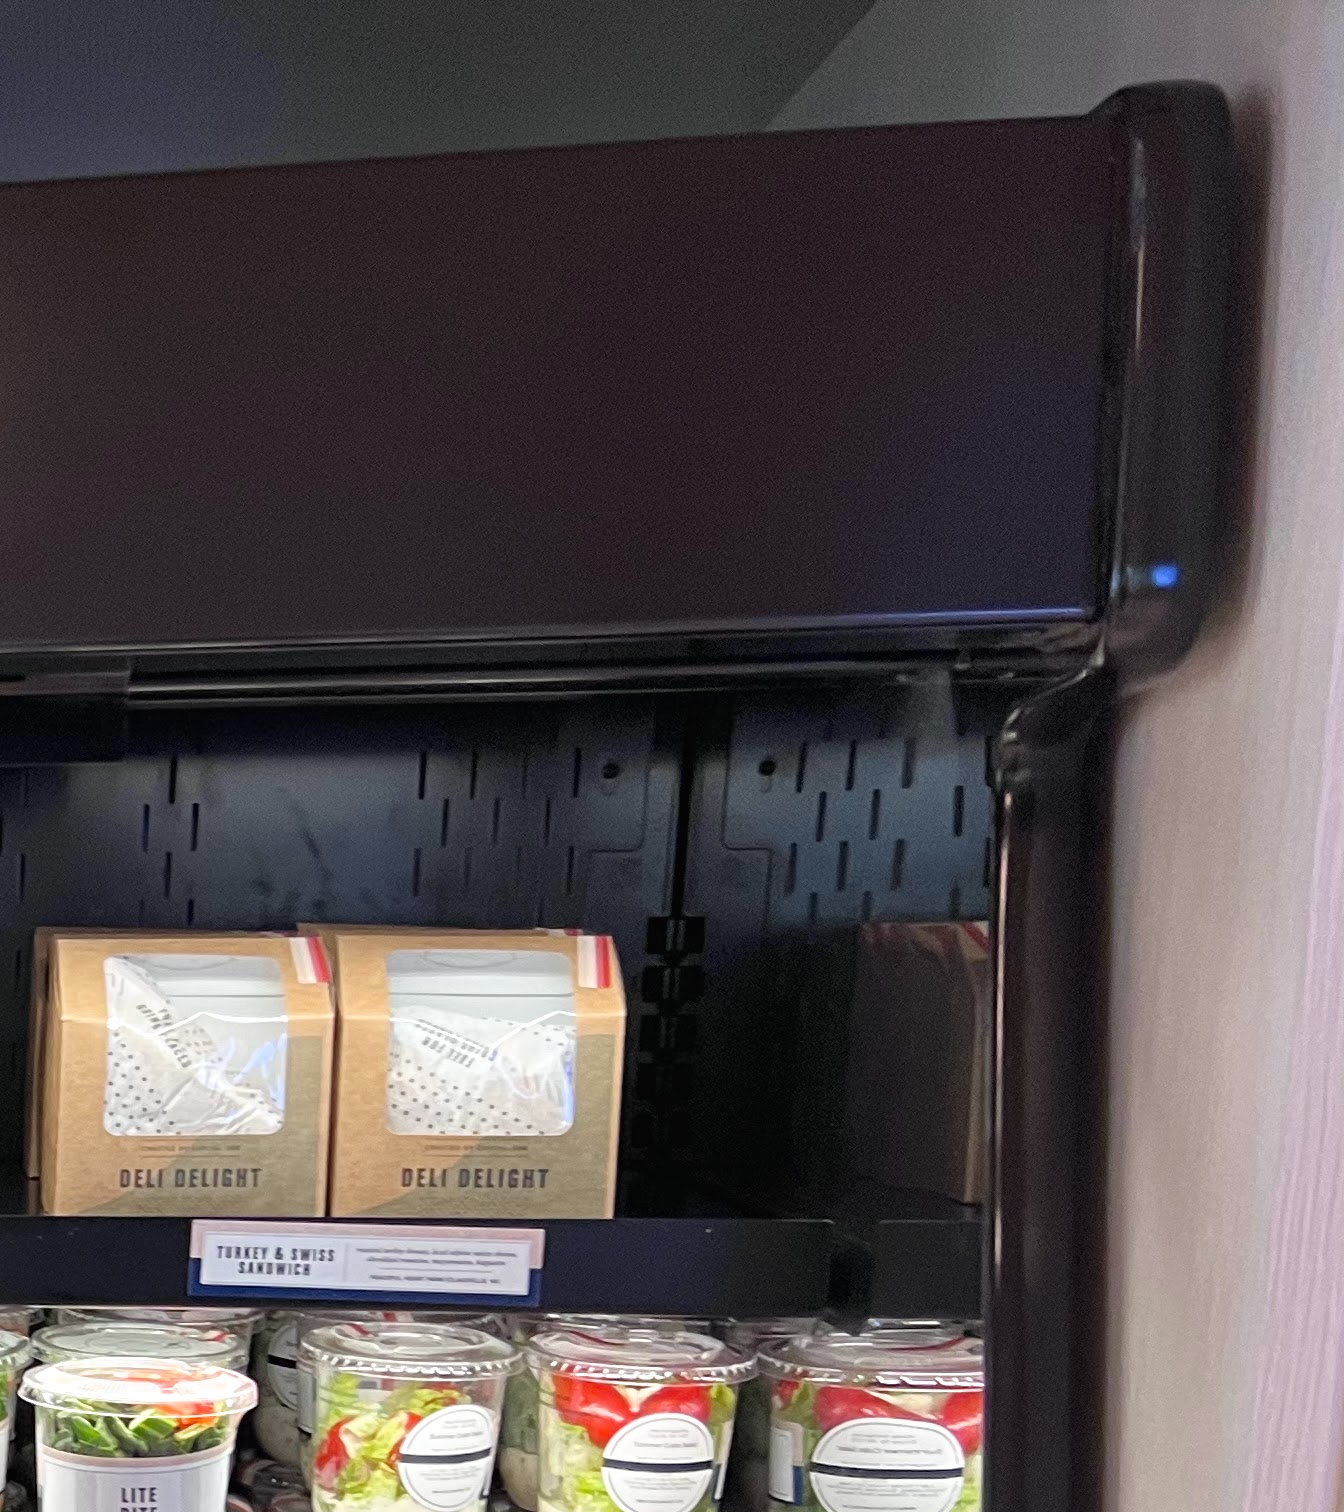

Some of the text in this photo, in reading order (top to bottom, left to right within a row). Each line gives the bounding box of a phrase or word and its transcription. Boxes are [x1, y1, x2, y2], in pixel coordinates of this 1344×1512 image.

[119, 1167, 261, 1188] DELI DELIGHT
[402, 1168, 549, 1189] DELI DELIGHT
[217, 1246, 335, 1262] TURKEY & SWISS
[238, 1261, 311, 1276] SANDWICH
[120, 1486, 157, 1504] LITE
